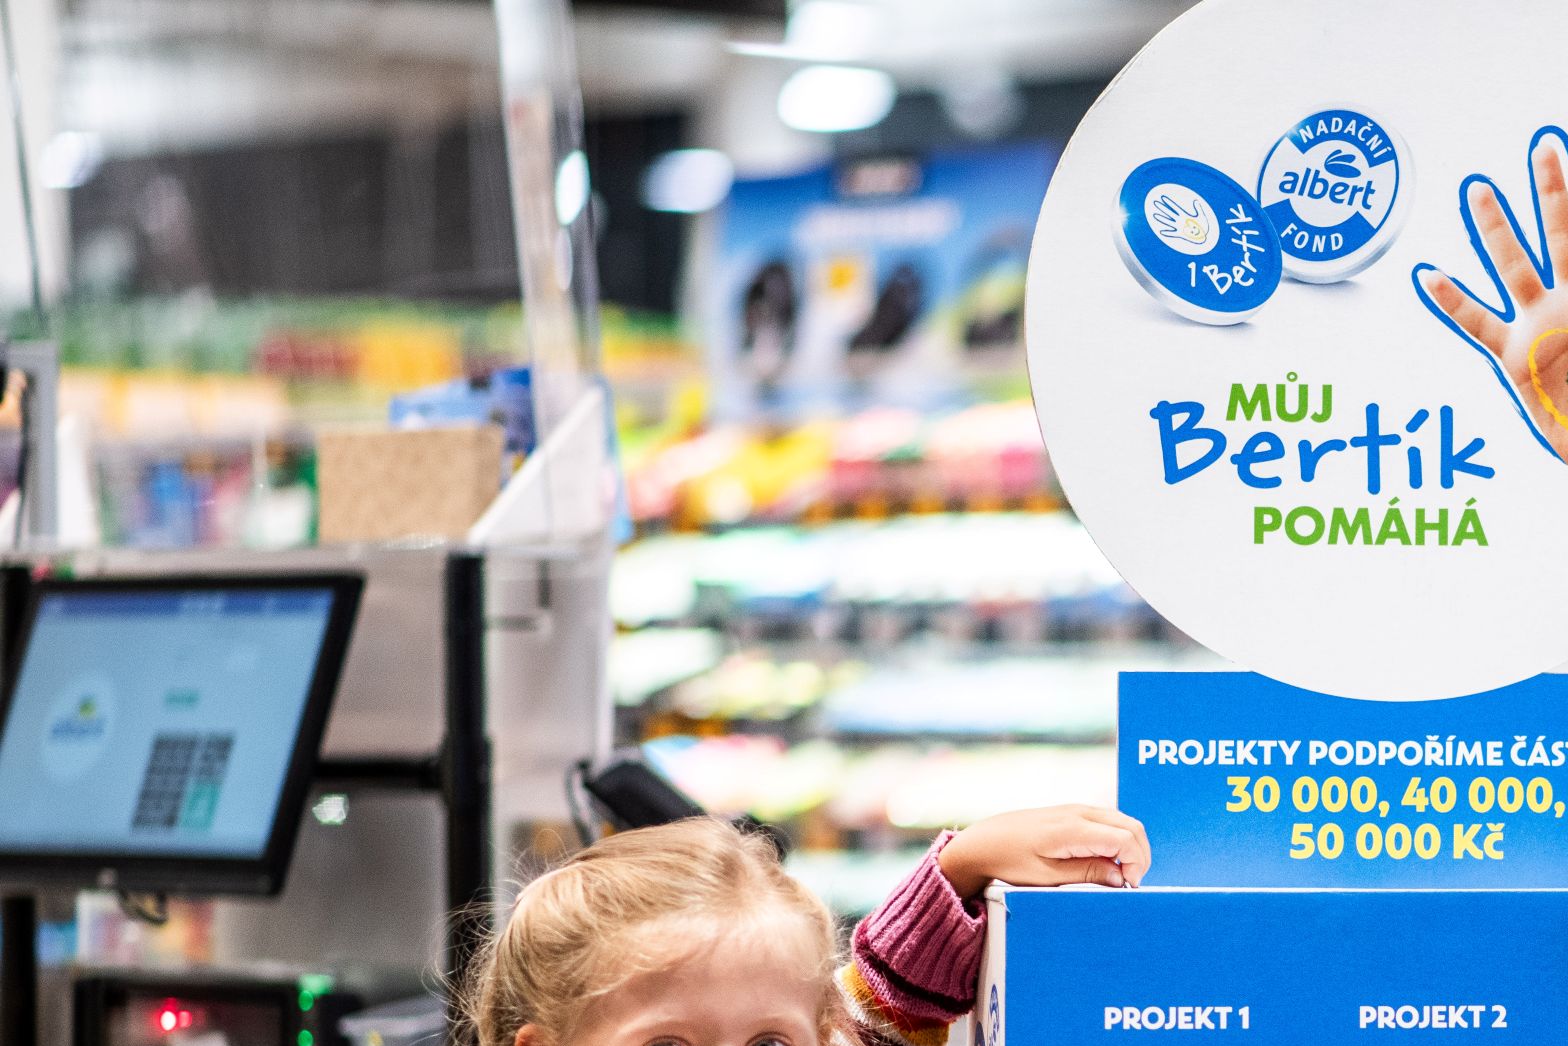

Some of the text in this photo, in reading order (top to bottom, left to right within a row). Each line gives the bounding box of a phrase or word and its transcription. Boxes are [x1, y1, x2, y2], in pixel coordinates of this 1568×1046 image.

[1299, 117, 1393, 158] NADAČNÍ
[1279, 167, 1376, 210] albert
[1188, 204, 1265, 294] 1 Bertík
[1280, 223, 1343, 252] FOND
[1226, 371, 1333, 423] MŮJ
[1149, 400, 1495, 495] Bertík
[1253, 496, 1489, 547] POMÁHÁ
[1138, 739, 1301, 766] PROJEKTY
[1308, 734, 1504, 767] PODPOŘÍME
[1226, 775, 1565, 818] 30 000, 40 000,
[1289, 821, 1505, 860] 50 000 Kč
[1104, 1006, 1249, 1030] PROJEKT 1
[1359, 1005, 1507, 1029] PROJEKT 2
